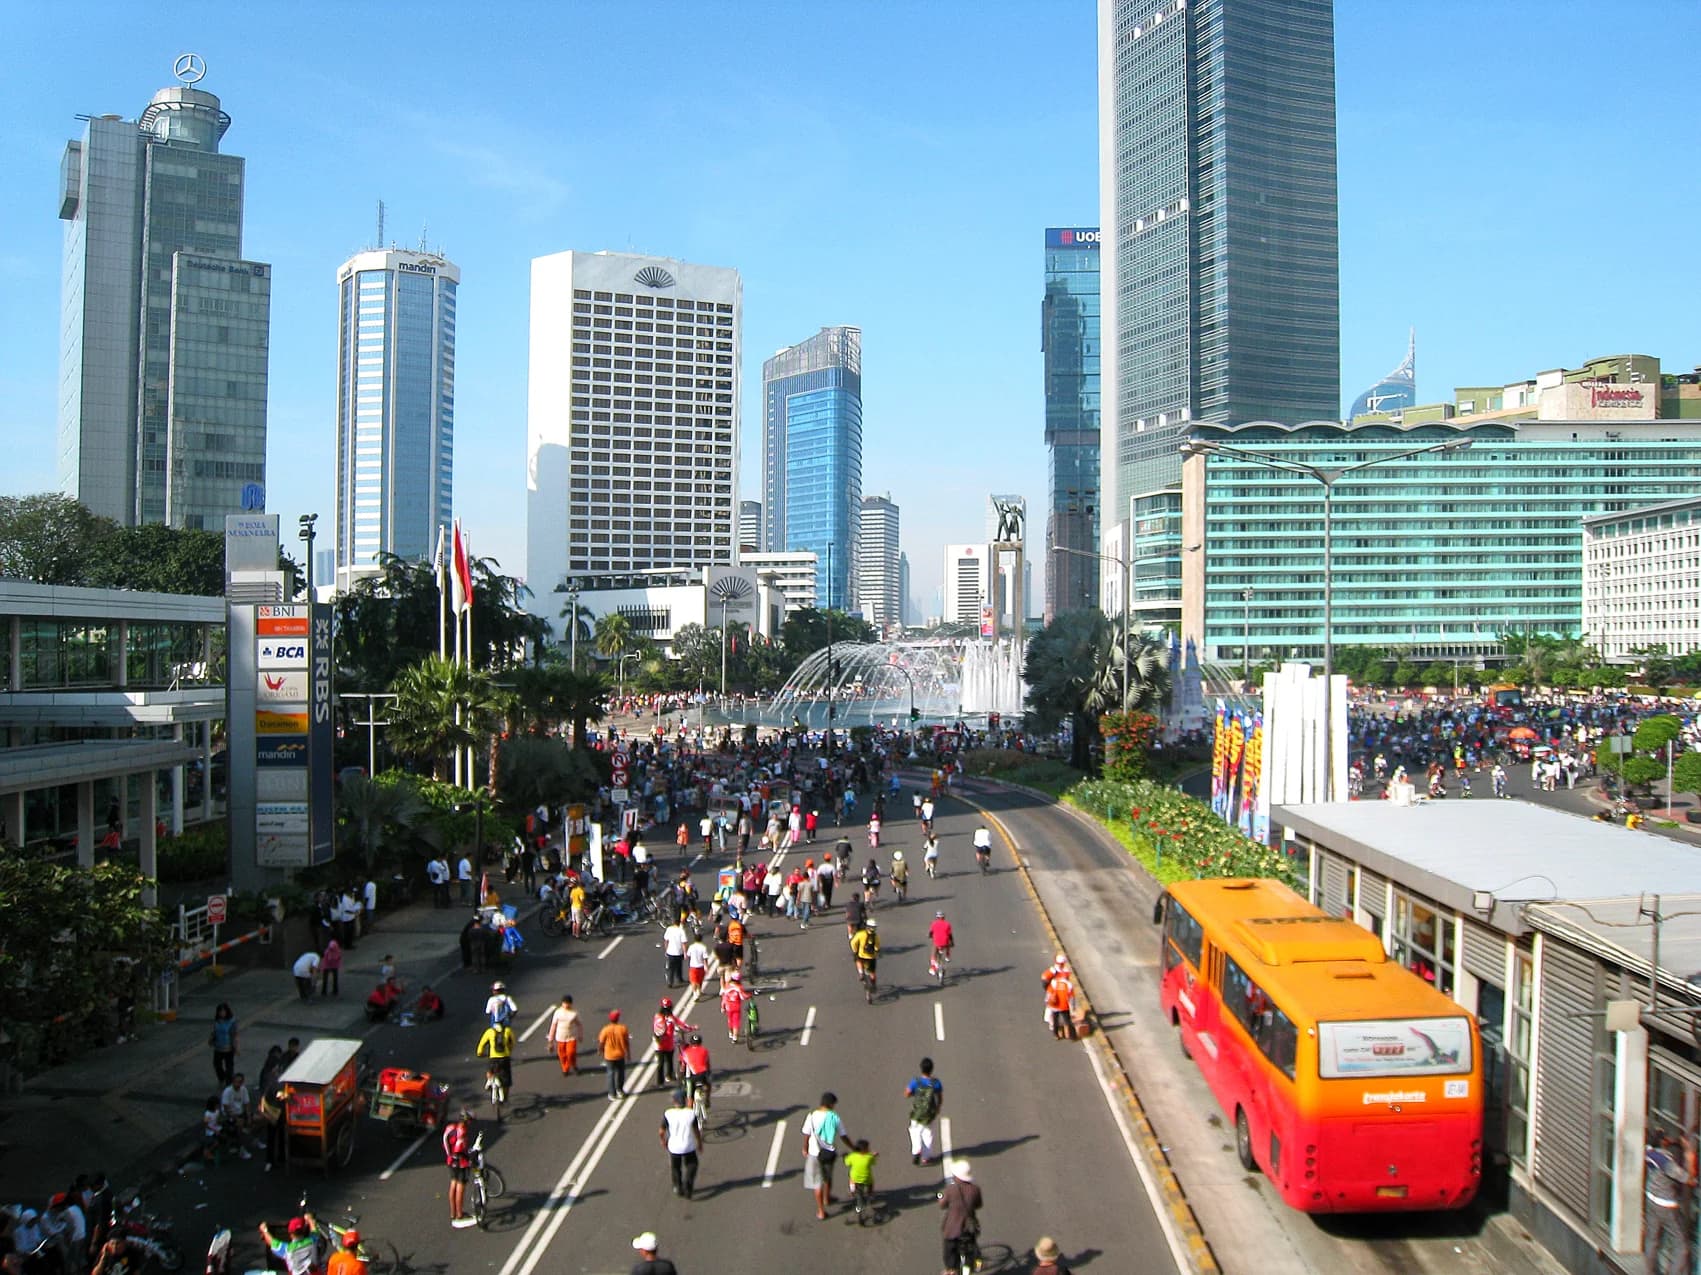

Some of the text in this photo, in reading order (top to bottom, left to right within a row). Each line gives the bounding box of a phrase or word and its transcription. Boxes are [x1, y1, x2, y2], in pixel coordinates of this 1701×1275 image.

[273, 606, 295, 617] BNI
[276, 647, 304, 658] BCA
[316, 657, 329, 723] RBS
